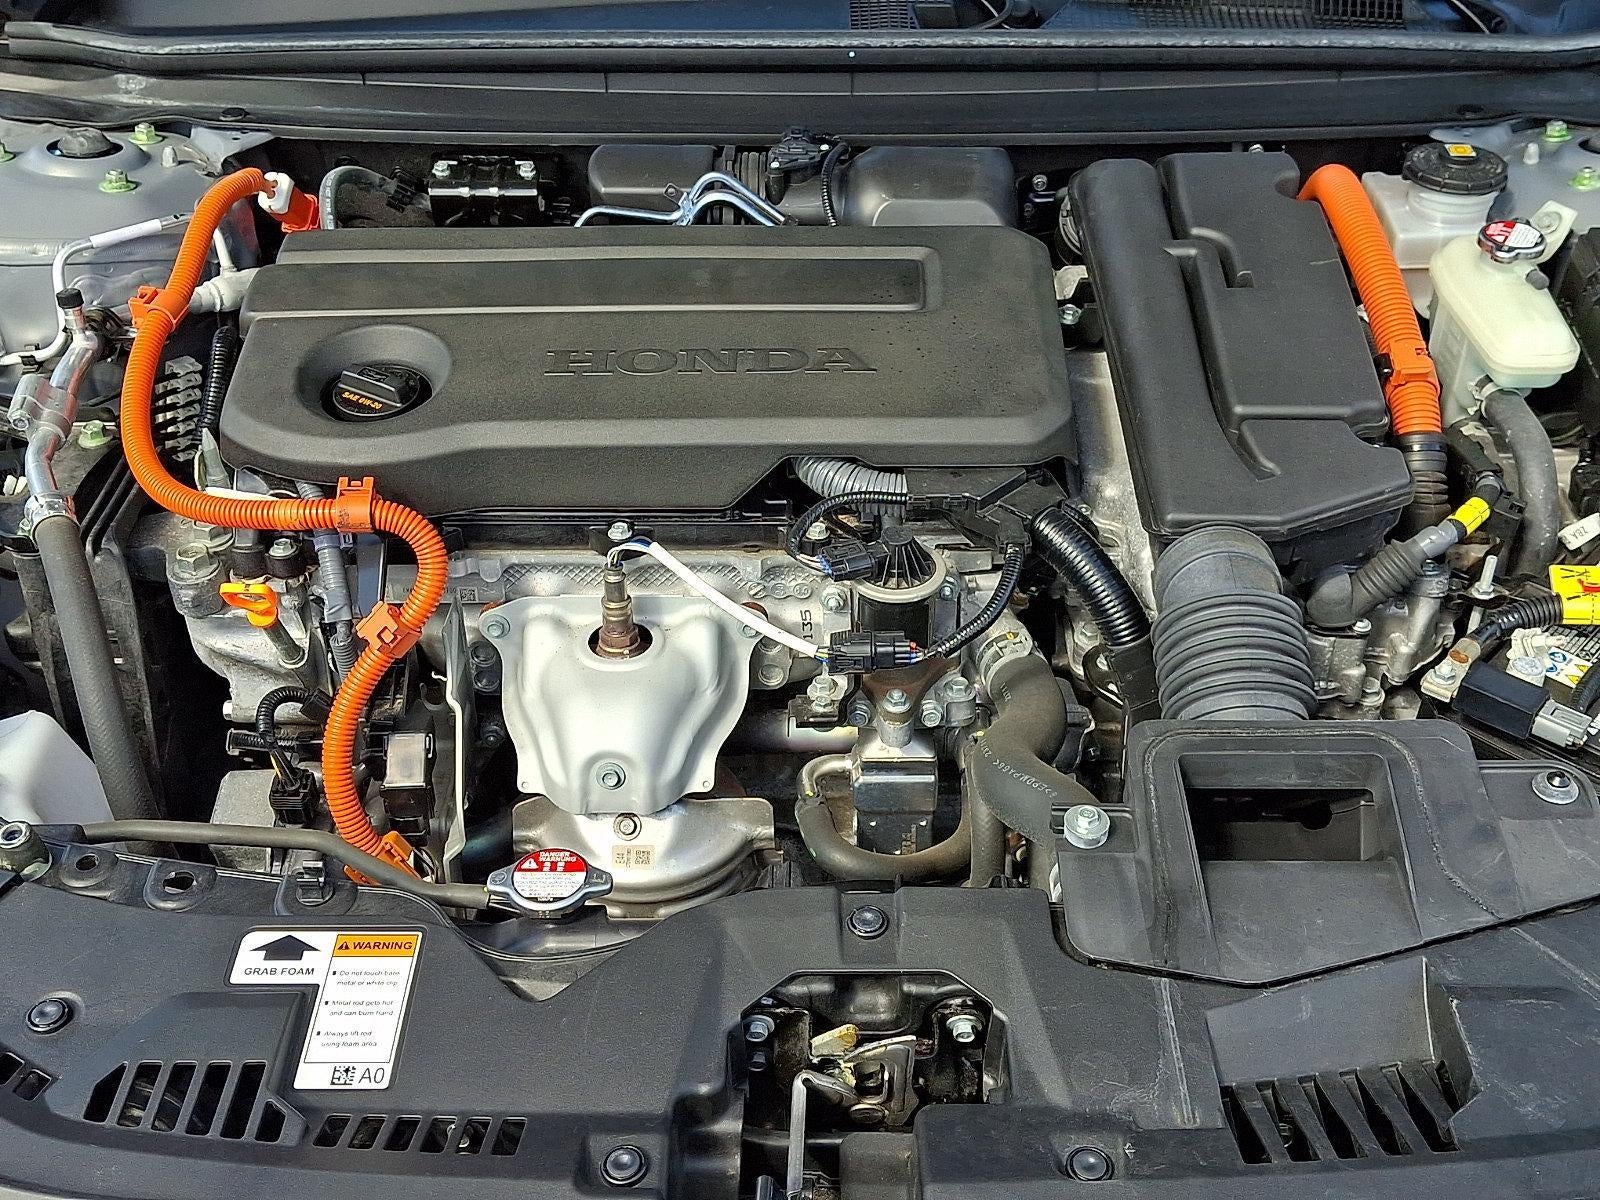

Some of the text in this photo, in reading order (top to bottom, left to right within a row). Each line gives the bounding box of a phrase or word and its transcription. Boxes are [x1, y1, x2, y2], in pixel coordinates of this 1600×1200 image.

[543, 347, 878, 375] HONDA
[341, 391, 359, 402] SAE
[799, 609, 814, 640] 135
[352, 941, 413, 950] WARNING
[244, 967, 315, 976] GRAB FOAM
